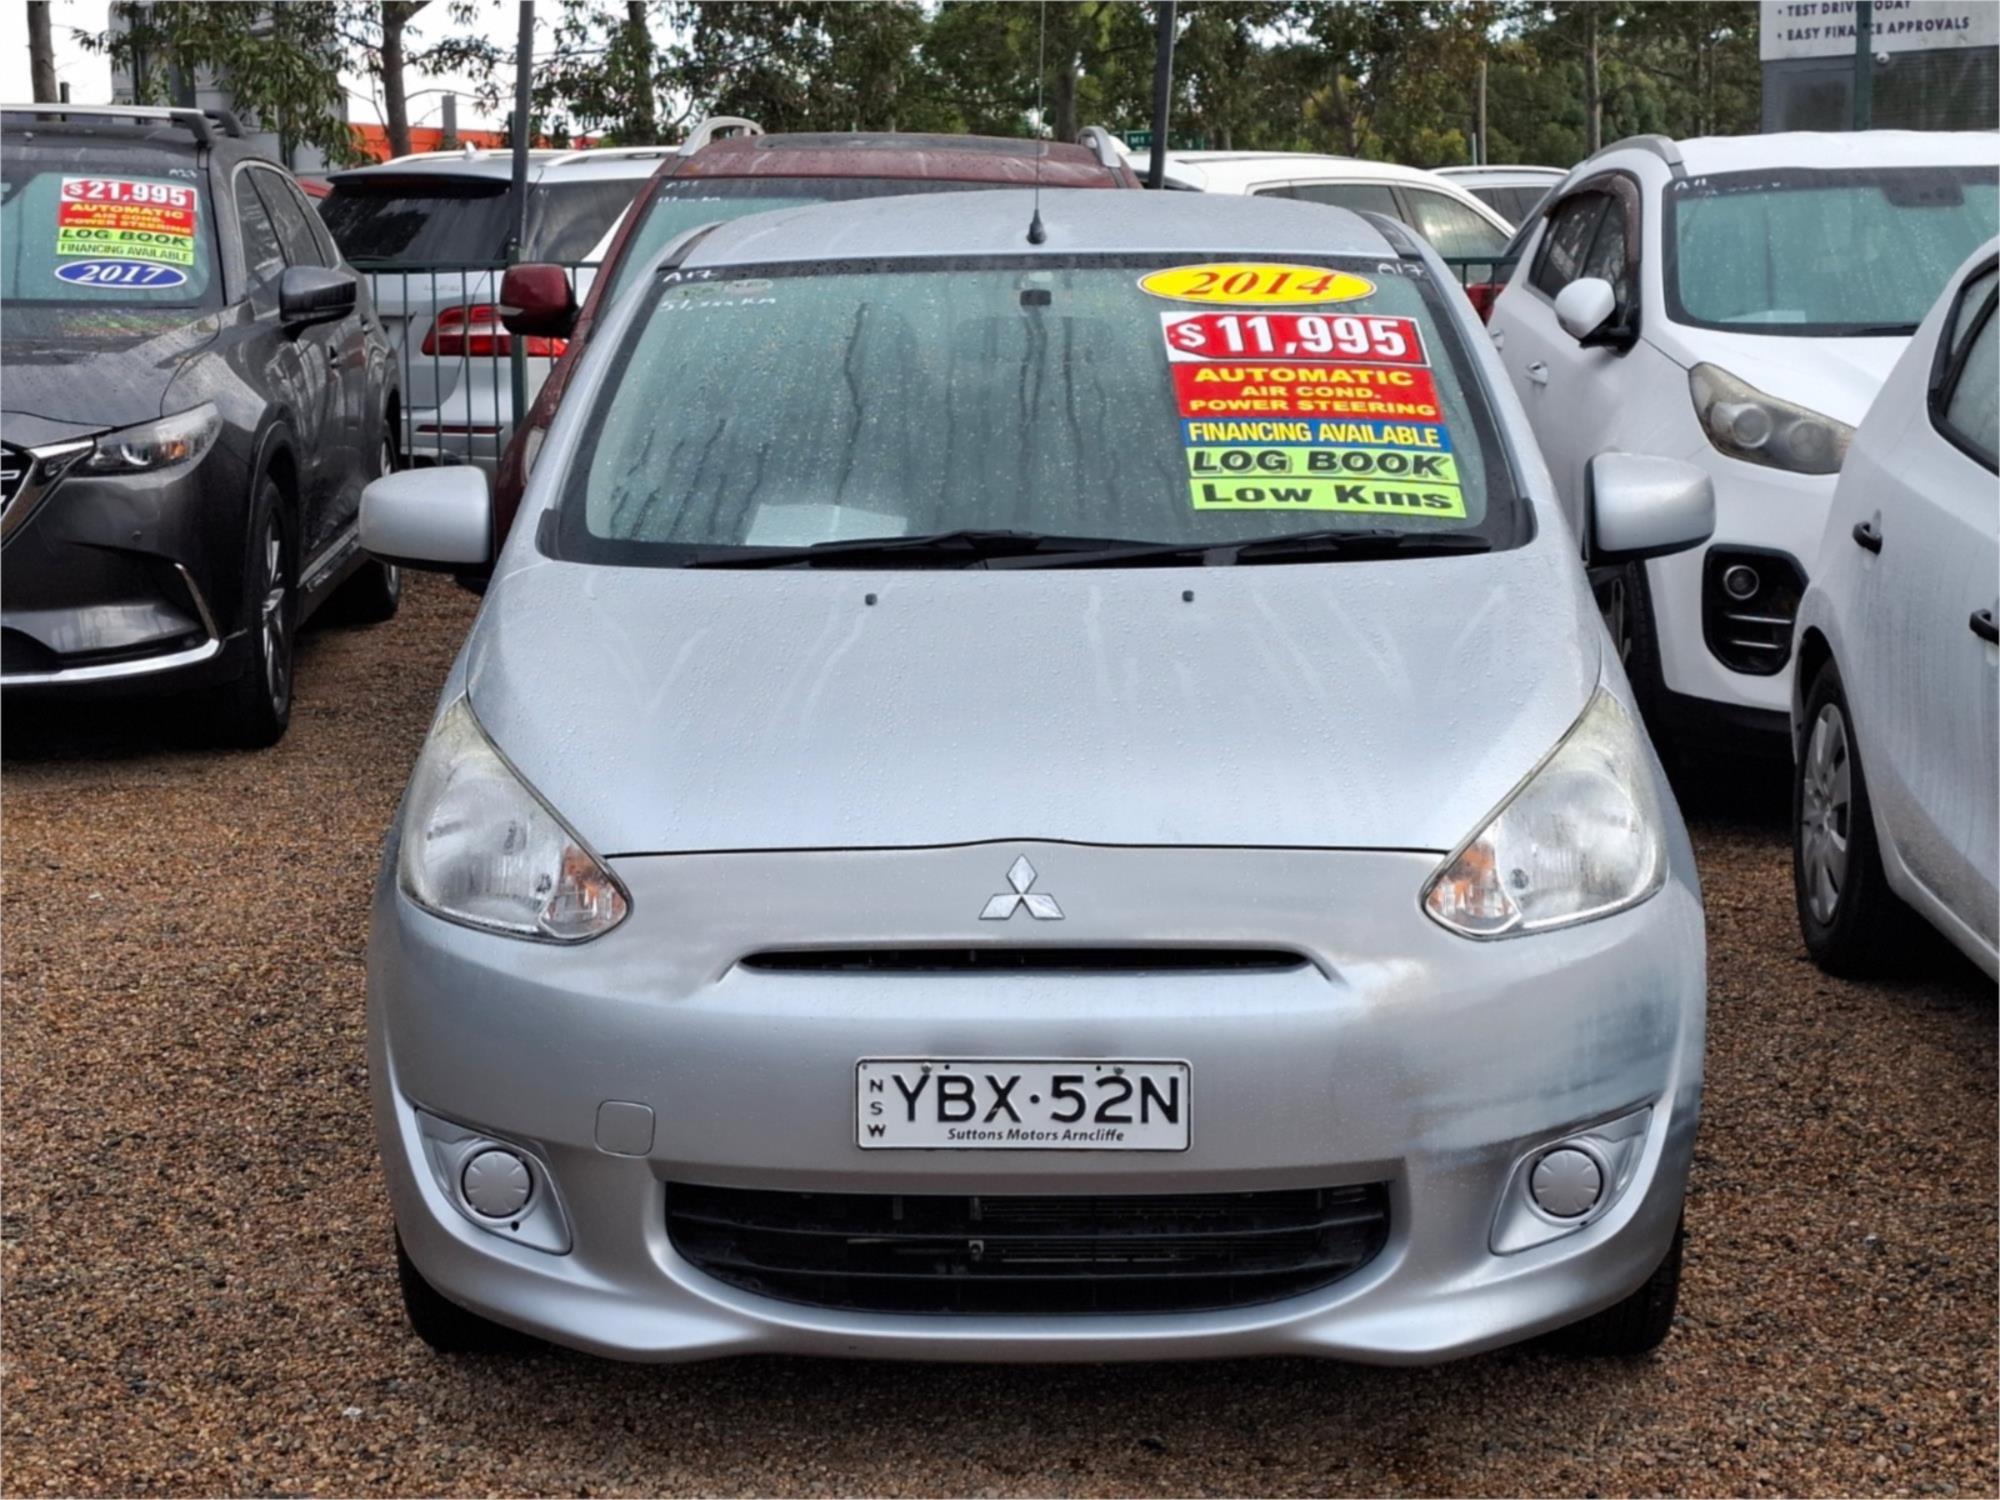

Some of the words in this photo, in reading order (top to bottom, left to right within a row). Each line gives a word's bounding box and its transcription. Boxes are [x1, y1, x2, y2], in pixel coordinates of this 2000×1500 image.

[1787, 4, 1817, 16] TEST
[1822, 2, 1857, 14] DRIV
[1873, 1, 1910, 11] ODAY
[1787, 28, 1820, 40] EASY
[1825, 23, 1882, 38] FINAE
[1888, 17, 1970, 34] APPROVALS
[69, 180, 188, 207] $21,995
[70, 203, 185, 219] AUTOMATIC
[92, 212, 118, 220] AIR
[64, 218, 117, 226] POWER
[119, 219, 191, 233] STEERING
[62, 229, 110, 240] LOG
[119, 231, 188, 247] BOOK
[60, 243, 124, 255] FINANCING
[126, 246, 189, 262] AVAILABLE
[77, 264, 167, 283] 2017
[1182, 271, 1337, 297] 2014
[1194, 367, 1415, 386] AUTOMATIC
[1240, 386, 1289, 398] AIR
[1296, 387, 1382, 400] COND.
[1189, 400, 1289, 412] POWER
[1301, 400, 1437, 416] STEERING
[1188, 422, 1313, 442] FINANCING
[1319, 423, 1442, 448] AVAILABLE
[1193, 450, 1293, 473] LOG
[1307, 451, 1452, 478] BOOK
[1201, 483, 1313, 503] Low
[1333, 485, 1454, 510] Kms
[947, 1128, 1003, 1141] Suttons
[1006, 1128, 1058, 1142] Motors
[1061, 1128, 1125, 1142] Arncliffe
